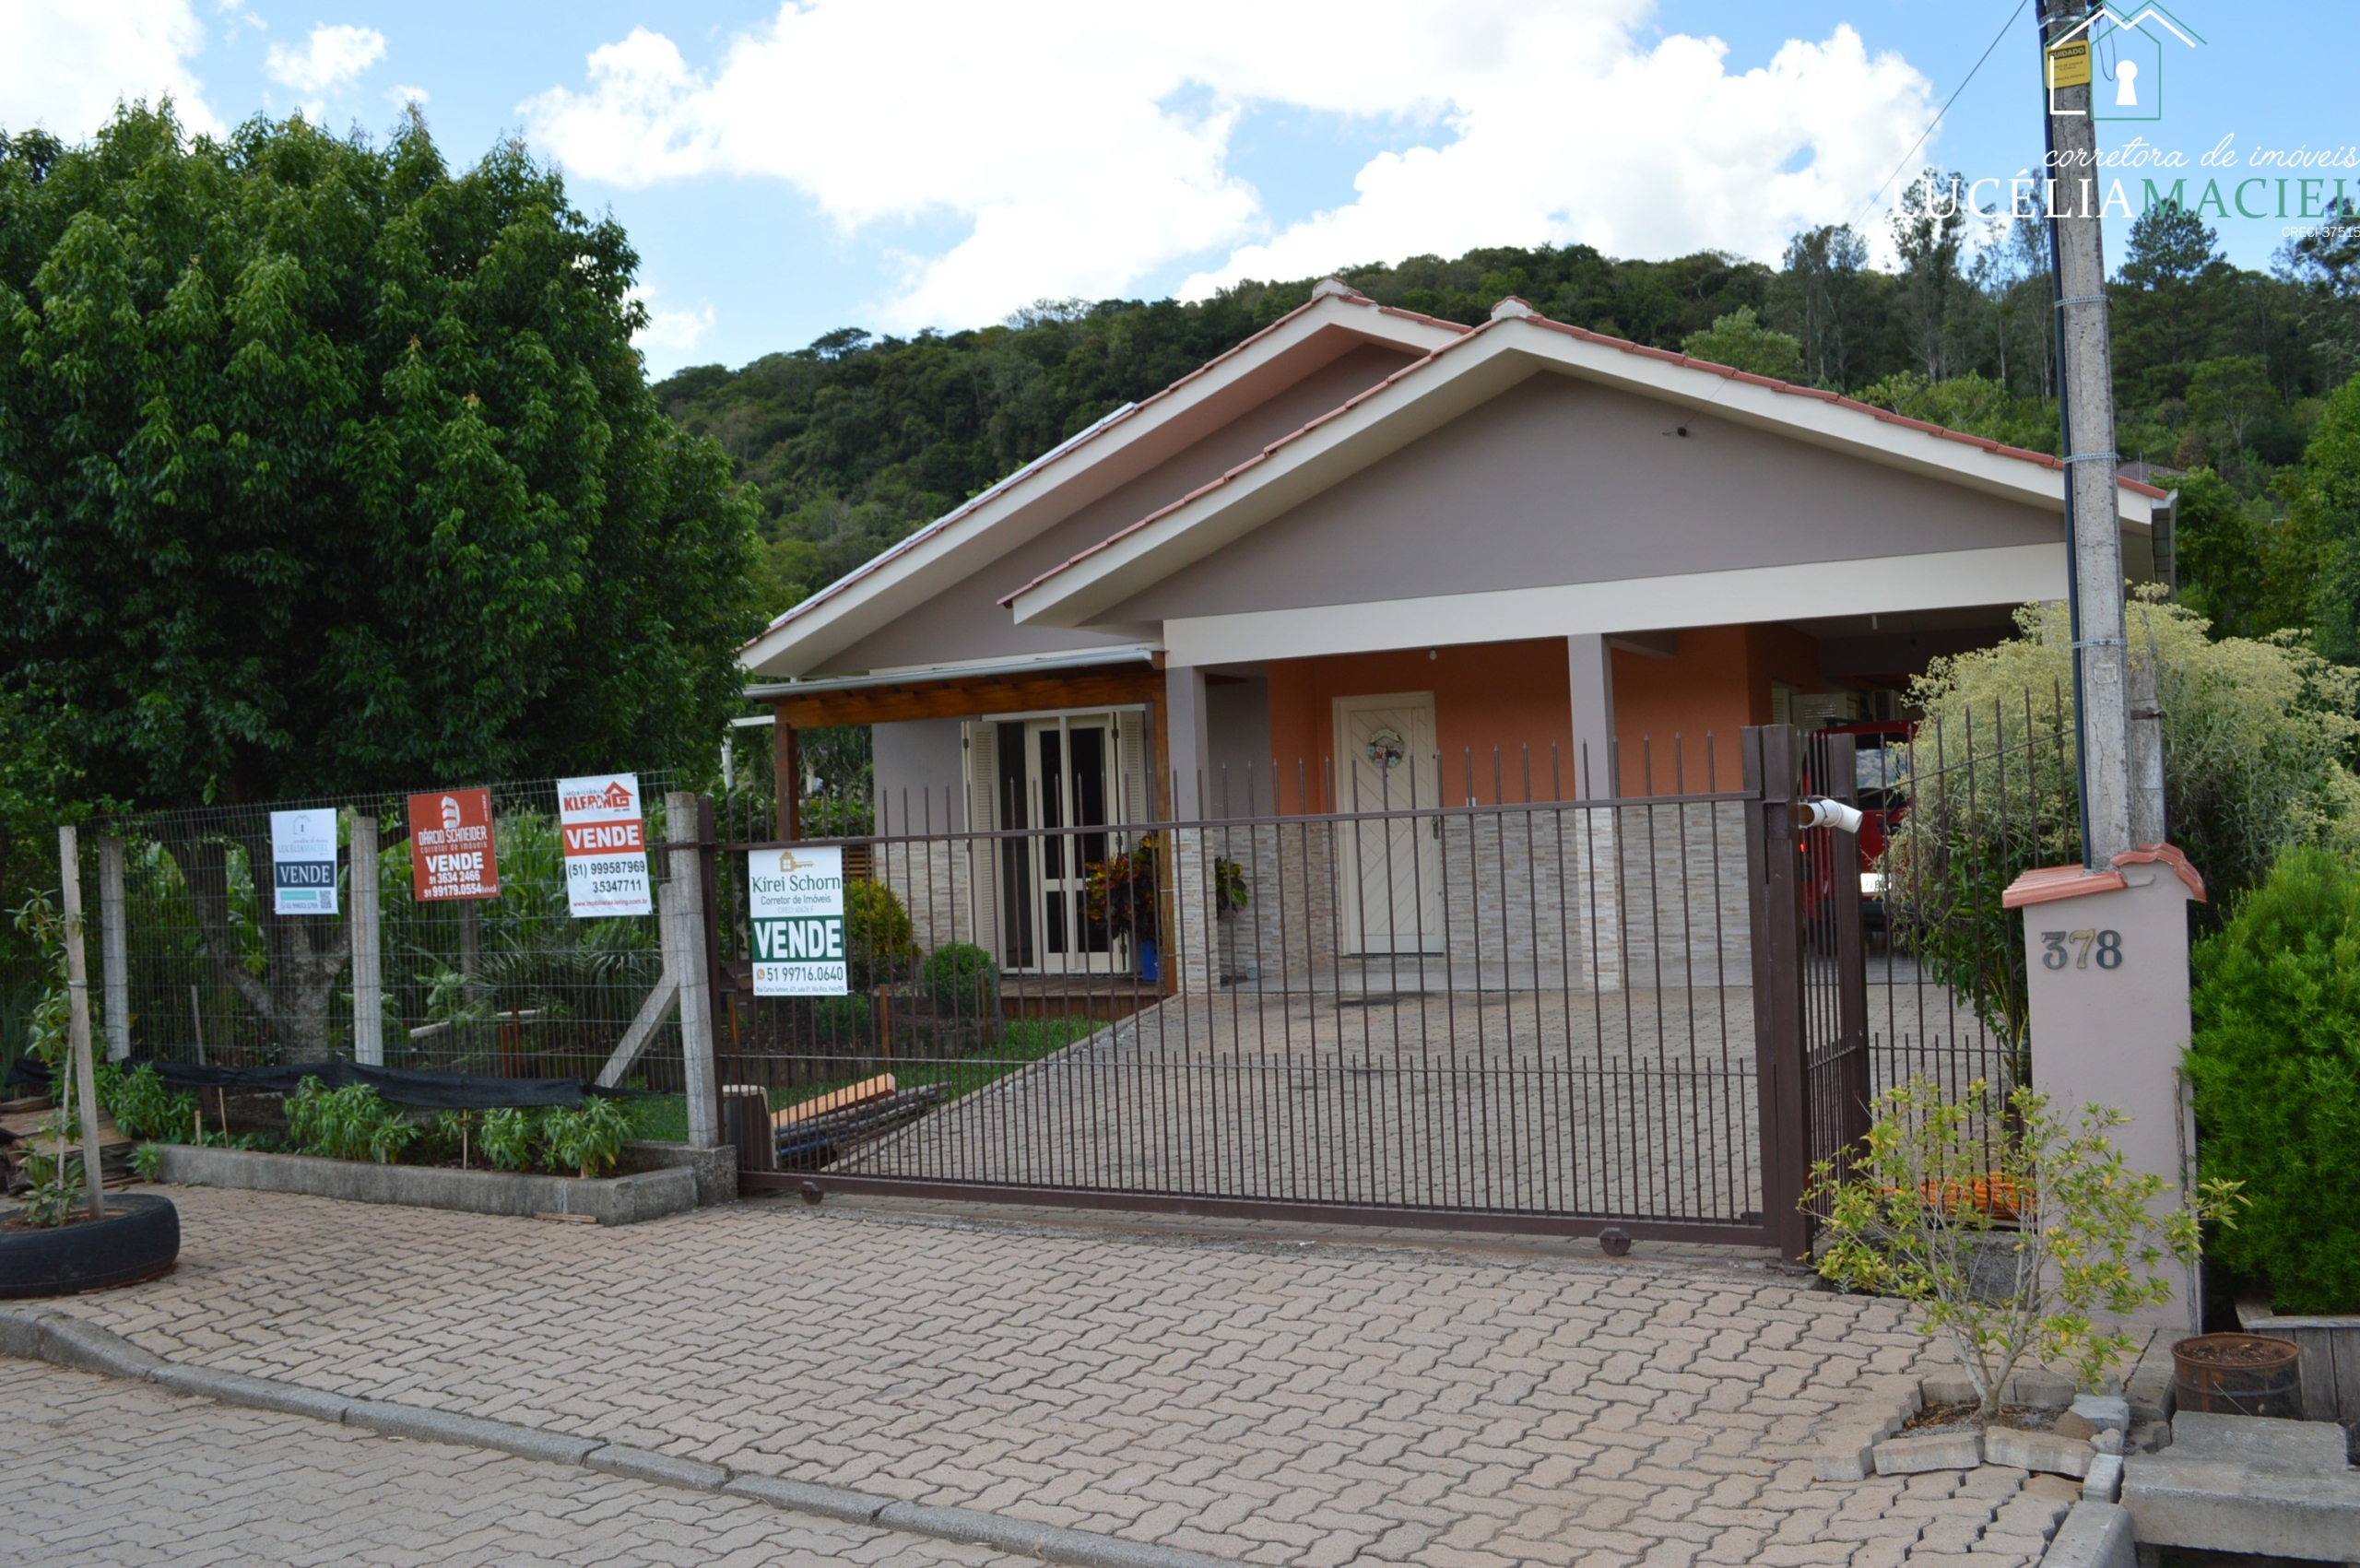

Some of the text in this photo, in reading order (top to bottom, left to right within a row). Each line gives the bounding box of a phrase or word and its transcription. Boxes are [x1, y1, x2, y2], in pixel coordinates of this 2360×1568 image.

[419, 826, 488, 846] DÁRCIO SCHNEIDER
[566, 824, 641, 850] VENDE
[420, 844, 448, 854] corretor
[425, 852, 484, 873] VENDE
[568, 860, 645, 878] (51) 999587969
[280, 865, 331, 884] VENDE
[429, 869, 480, 884] 51 3634 2466
[751, 874, 841, 892] Kírei Schorn
[424, 889, 431, 898] 51
[431, 882, 481, 897] 99179.0554
[593, 878, 642, 893] 35347711
[761, 893, 832, 905] Corretor de Imóveis
[754, 919, 843, 959] VENDE
[2041, 928, 2122, 970] 378
[767, 965, 843, 981] 51 99716.0640
